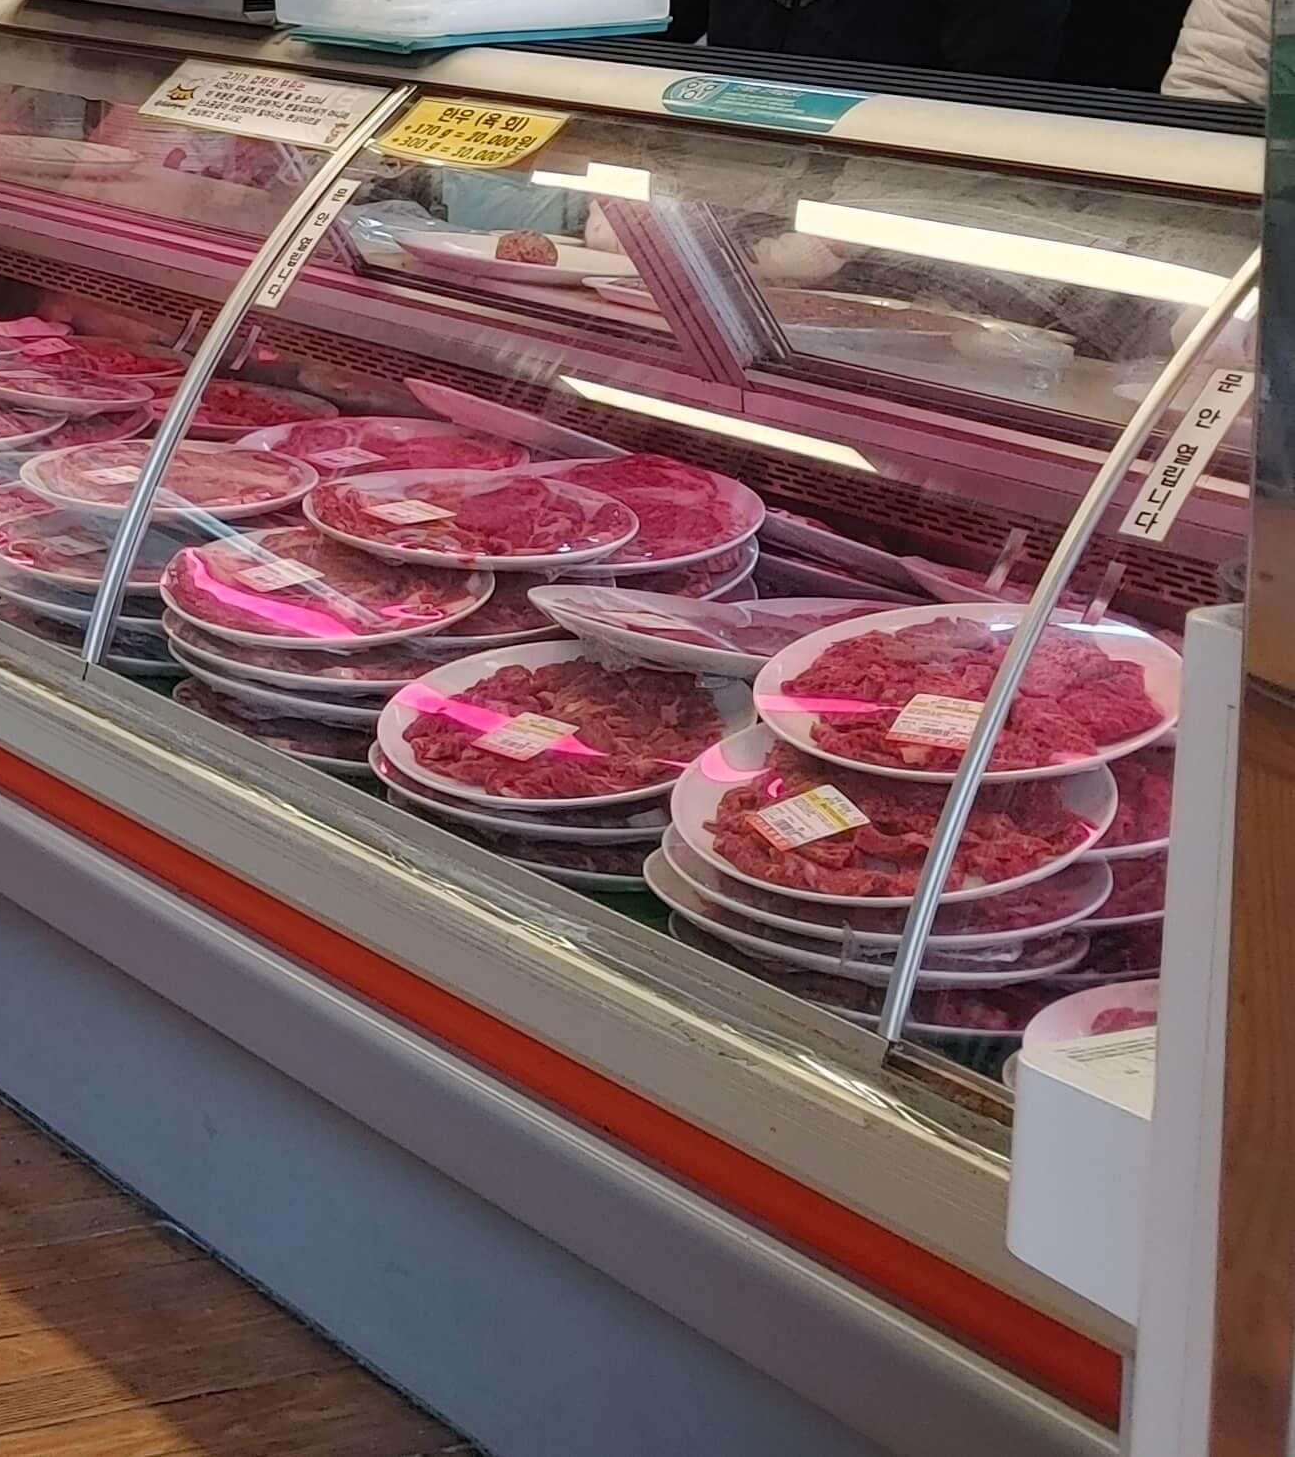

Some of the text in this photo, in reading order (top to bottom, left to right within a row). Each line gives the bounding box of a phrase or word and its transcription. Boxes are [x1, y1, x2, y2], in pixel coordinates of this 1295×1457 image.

[437, 106, 475, 125] 한우
[1195, 407, 1222, 429] 안
[1134, 443, 1199, 535] 열립니다
